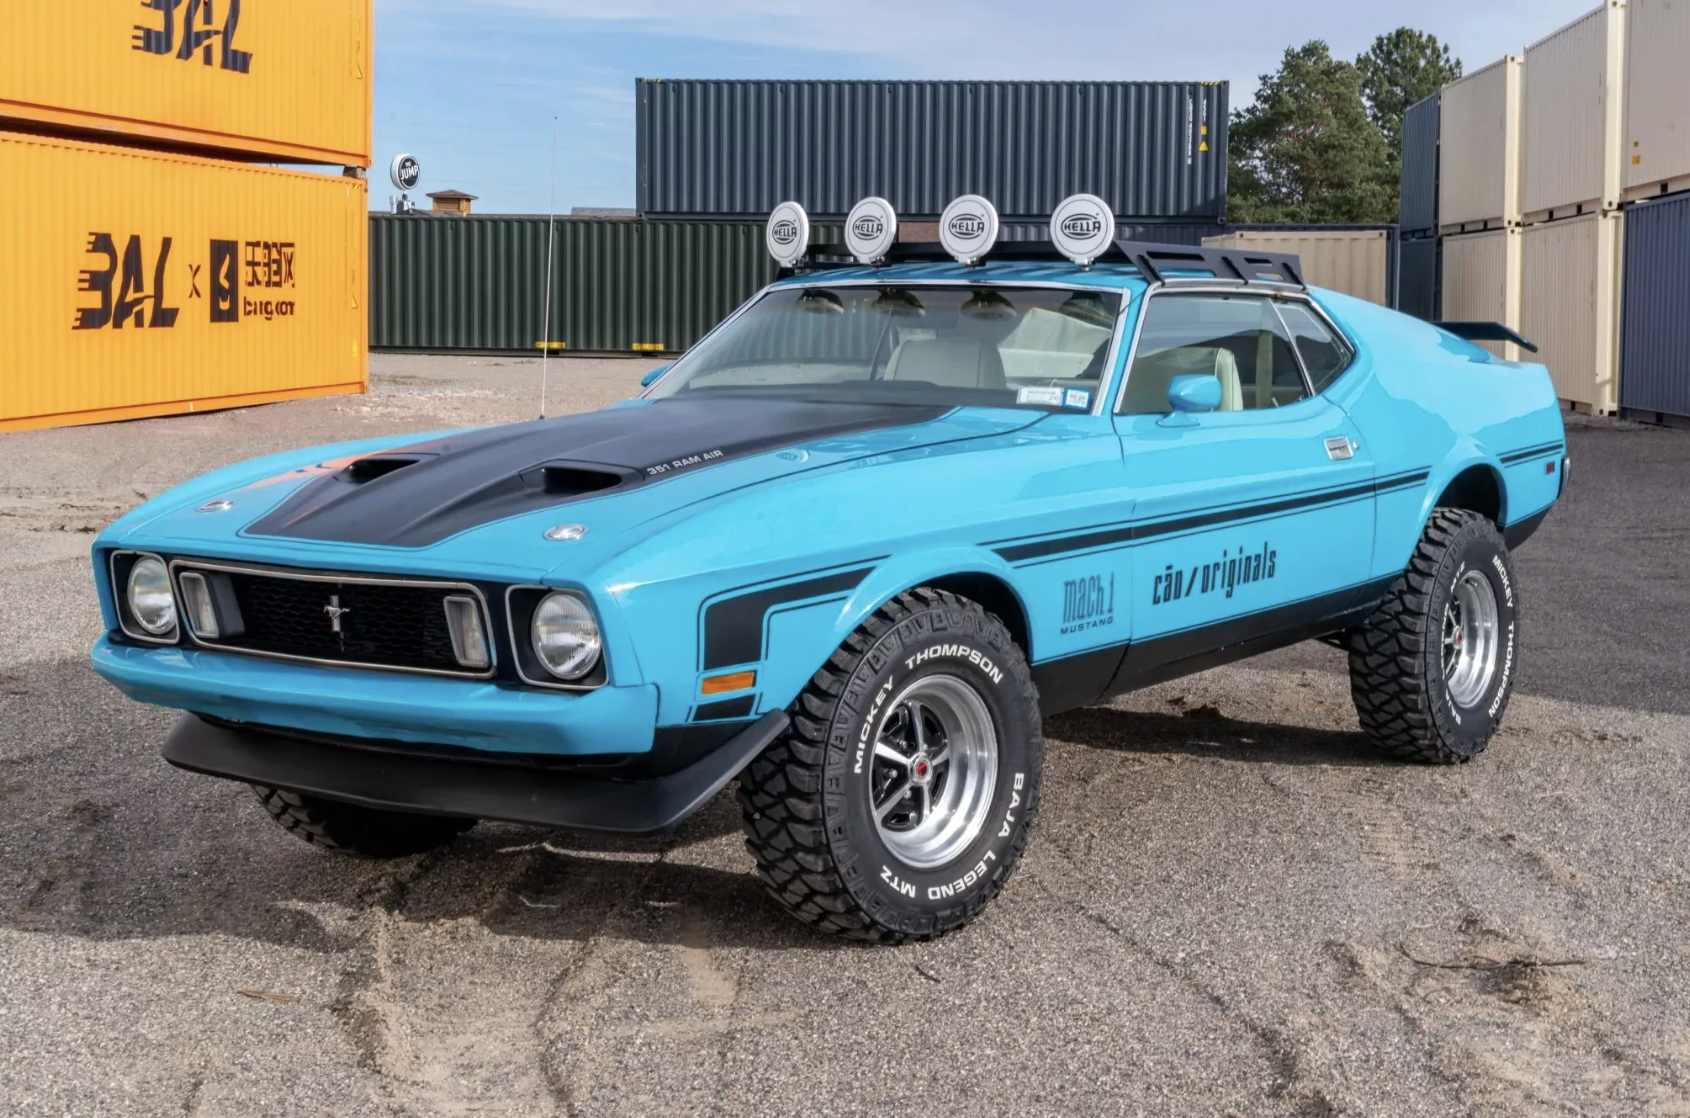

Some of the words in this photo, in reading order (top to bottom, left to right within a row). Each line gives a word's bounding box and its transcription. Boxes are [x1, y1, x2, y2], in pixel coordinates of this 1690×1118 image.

[401, 165, 419, 180] JUMP
[773, 226, 797, 239] HELLA
[854, 222, 883, 235] HELLA
[951, 220, 985, 233] HELLA
[1064, 220, 1101, 233] HELLA
[647, 464, 671, 475] 351
[672, 455, 701, 468] RAM
[703, 449, 723, 460] AIR
[1492, 554, 1513, 608] MICKEY
[1062, 574, 1104, 624] mach
[1060, 616, 1114, 635] MUSTANG
[1488, 621, 1514, 718] THOMPSON
[854, 676, 894, 774] MICKEY
[905, 644, 1004, 684] THOMPSON
[998, 773, 1025, 838] BAJA
[879, 864, 917, 899] MTZ
[928, 849, 997, 900] LEGEND
